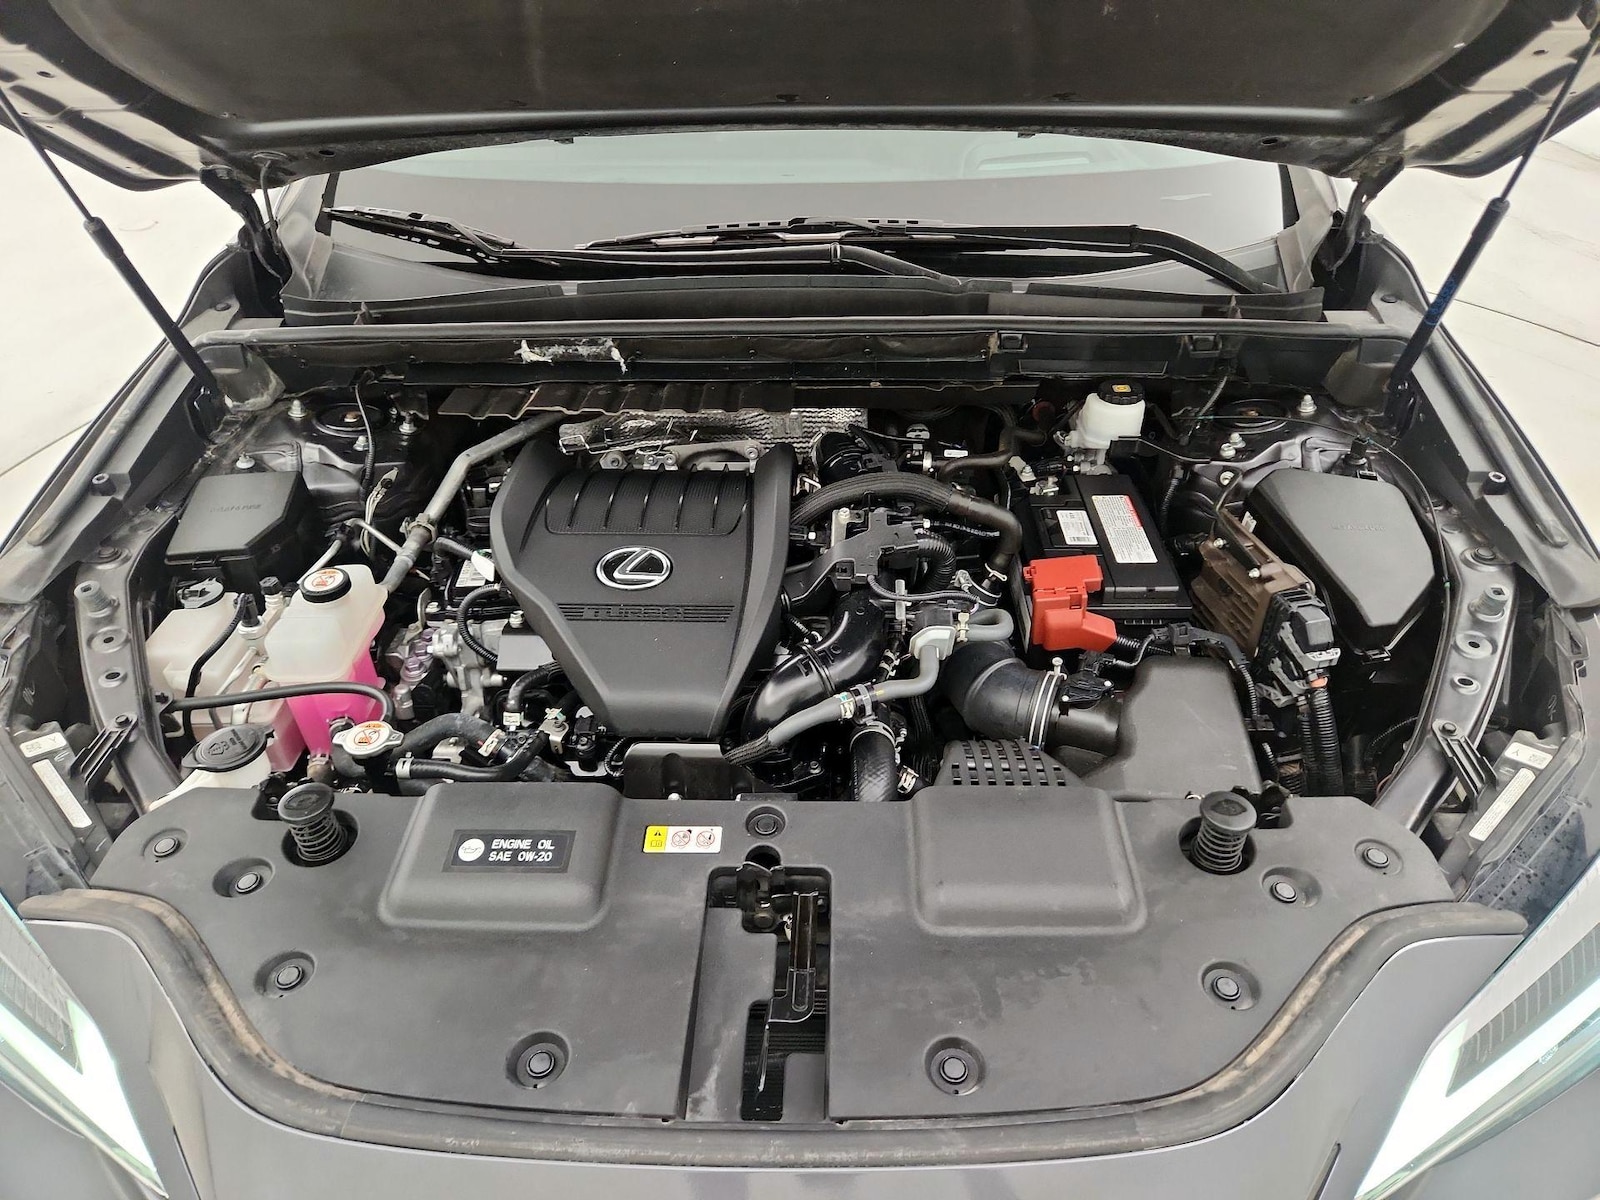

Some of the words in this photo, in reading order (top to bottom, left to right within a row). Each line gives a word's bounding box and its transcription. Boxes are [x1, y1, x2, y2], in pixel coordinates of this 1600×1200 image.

[491, 839, 532, 850] ENGINE
[537, 840, 555, 850] OIL
[488, 851, 512, 862] SAE
[517, 851, 553, 862] 0W-20
